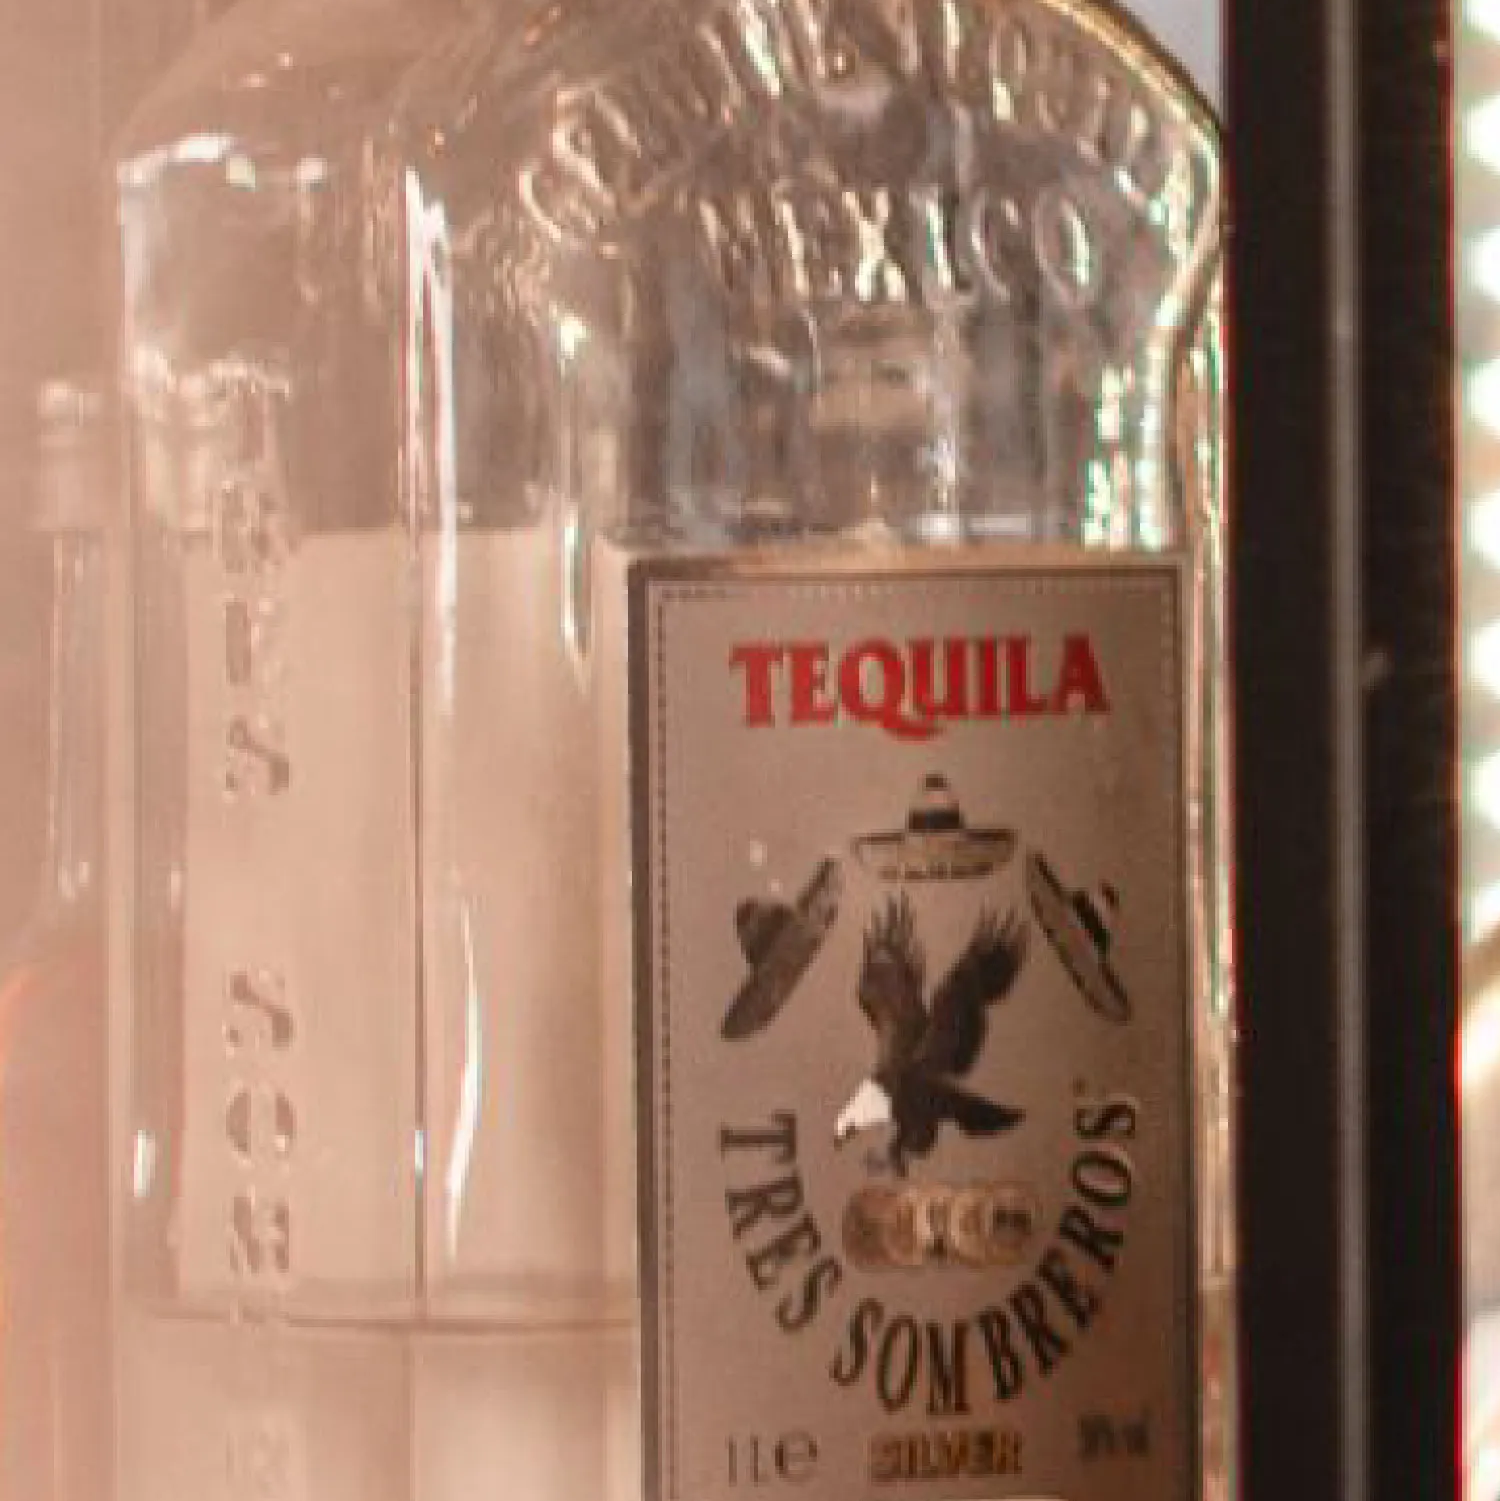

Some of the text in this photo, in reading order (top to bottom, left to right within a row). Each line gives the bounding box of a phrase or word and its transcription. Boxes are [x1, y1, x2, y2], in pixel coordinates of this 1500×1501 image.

[729, 632, 1110, 742] TEQUILA
[717, 1096, 1138, 1416] TRES SOMBREROS
[867, 1430, 1023, 1484] SILVER
